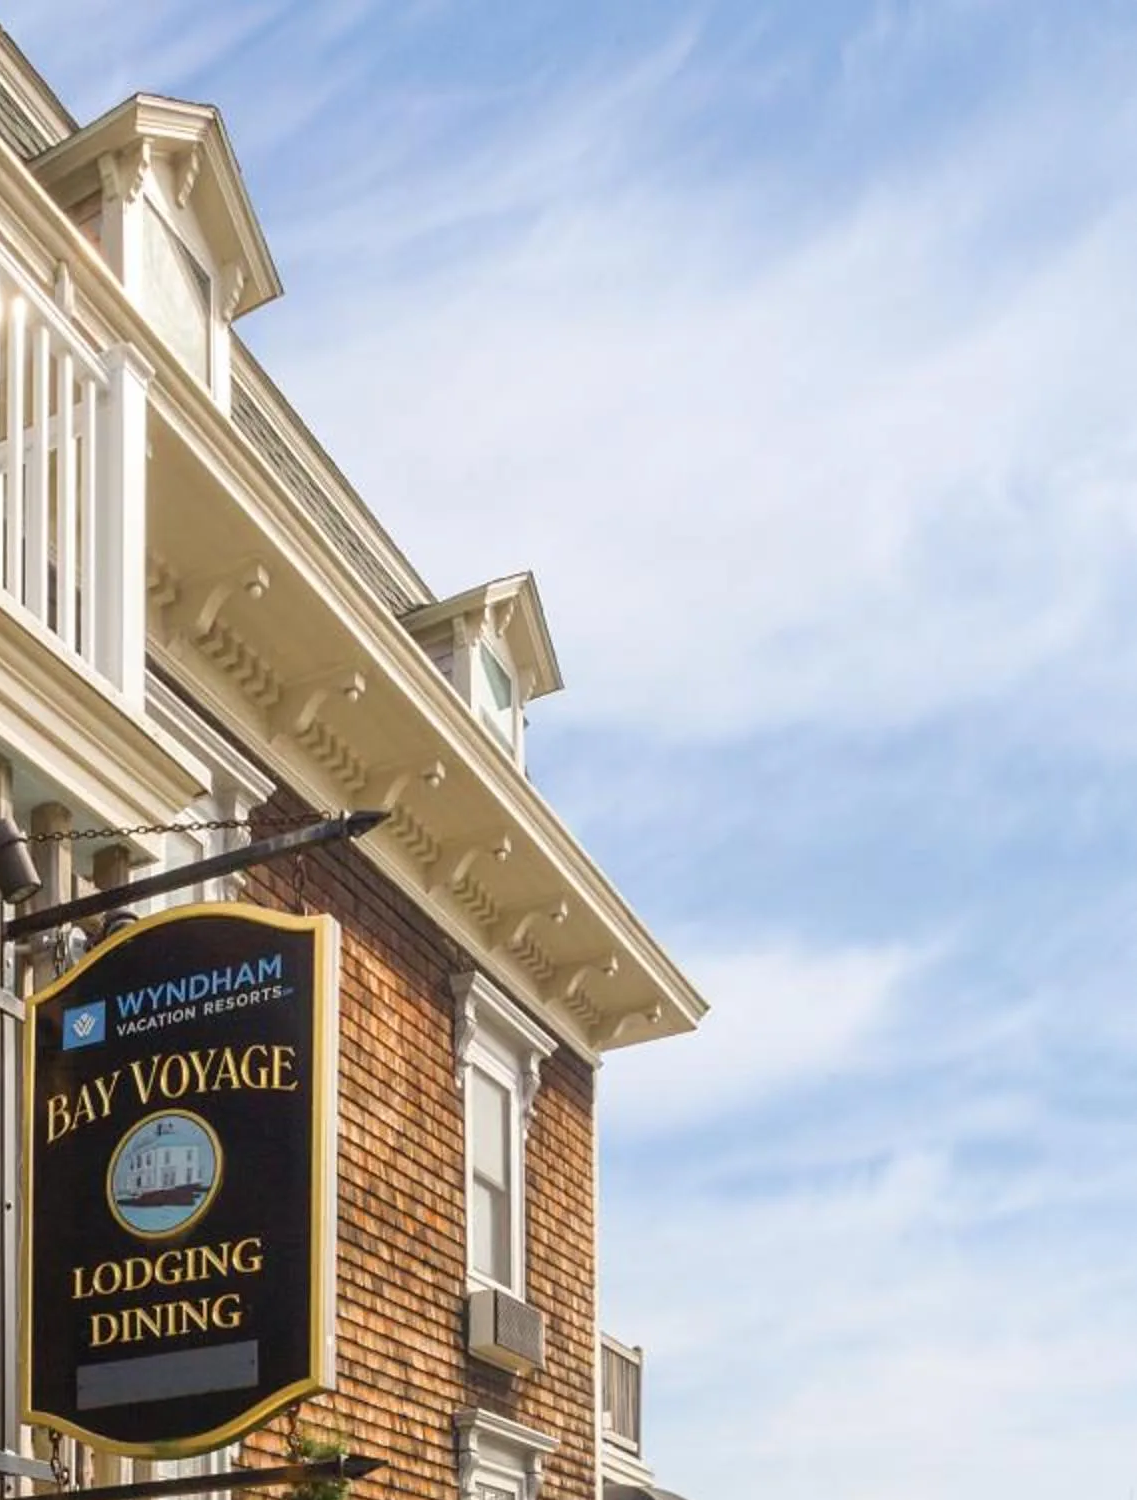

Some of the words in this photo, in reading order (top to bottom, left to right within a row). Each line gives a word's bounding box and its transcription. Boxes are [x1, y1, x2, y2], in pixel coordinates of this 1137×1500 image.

[116, 953, 282, 1018] WYNDHAM
[116, 1005, 196, 1037] VACATION
[203, 985, 283, 1016] RESORTS
[46, 1070, 120, 1144] BAY
[130, 1044, 299, 1105] VOYAGE
[71, 1237, 264, 1299] LODGING
[89, 1294, 243, 1347] DINING
